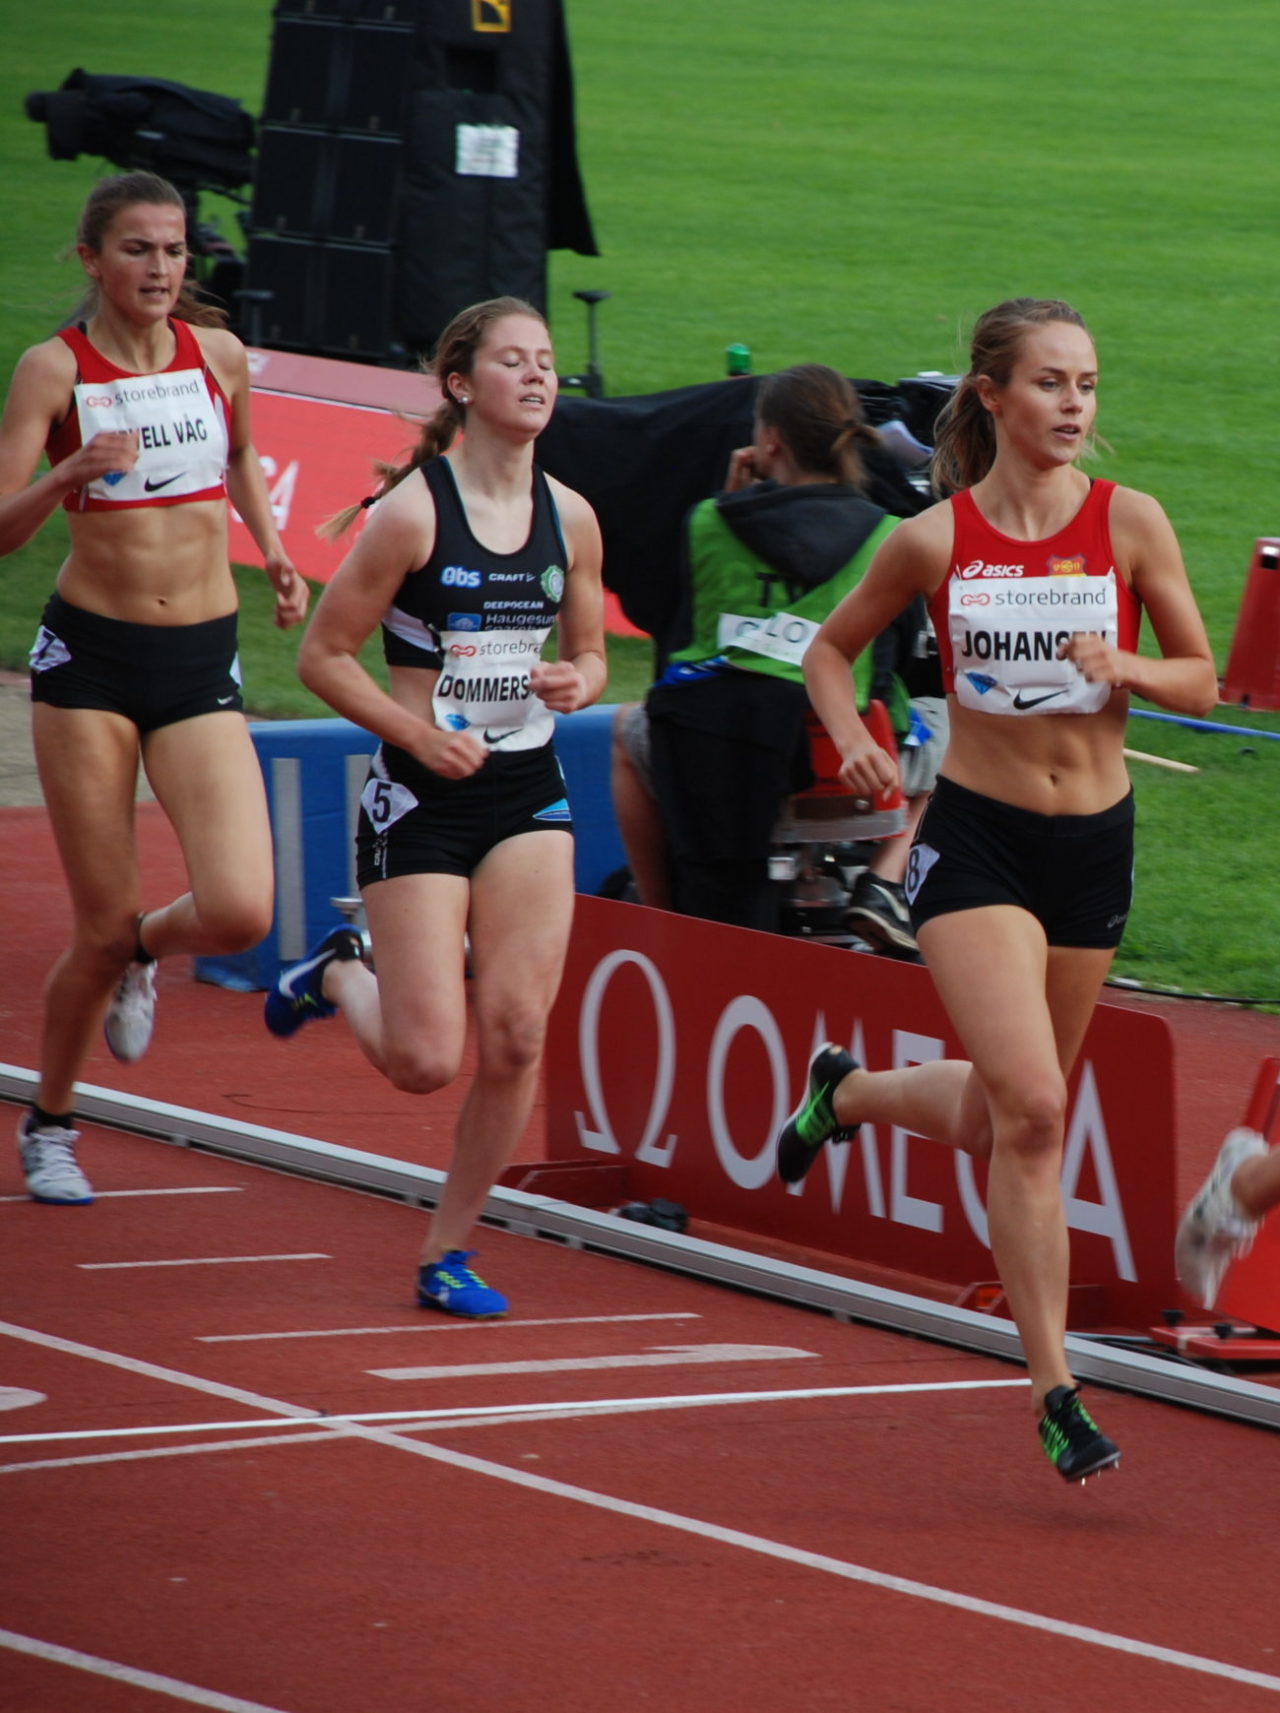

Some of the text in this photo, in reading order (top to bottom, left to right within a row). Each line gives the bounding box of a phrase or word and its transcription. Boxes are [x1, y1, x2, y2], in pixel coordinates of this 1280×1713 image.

[114, 379, 200, 406] storebrand
[488, 572, 525, 582] CRAFT
[982, 564, 1025, 577] asics
[483, 601, 544, 610] DEEPOCEAN
[994, 588, 1107, 606] storebrand
[961, 629, 1107, 662] JOHANS
[437, 674, 535, 703] DOMMERS
[373, 782, 392, 823] 5
[907, 848, 920, 893] 8
